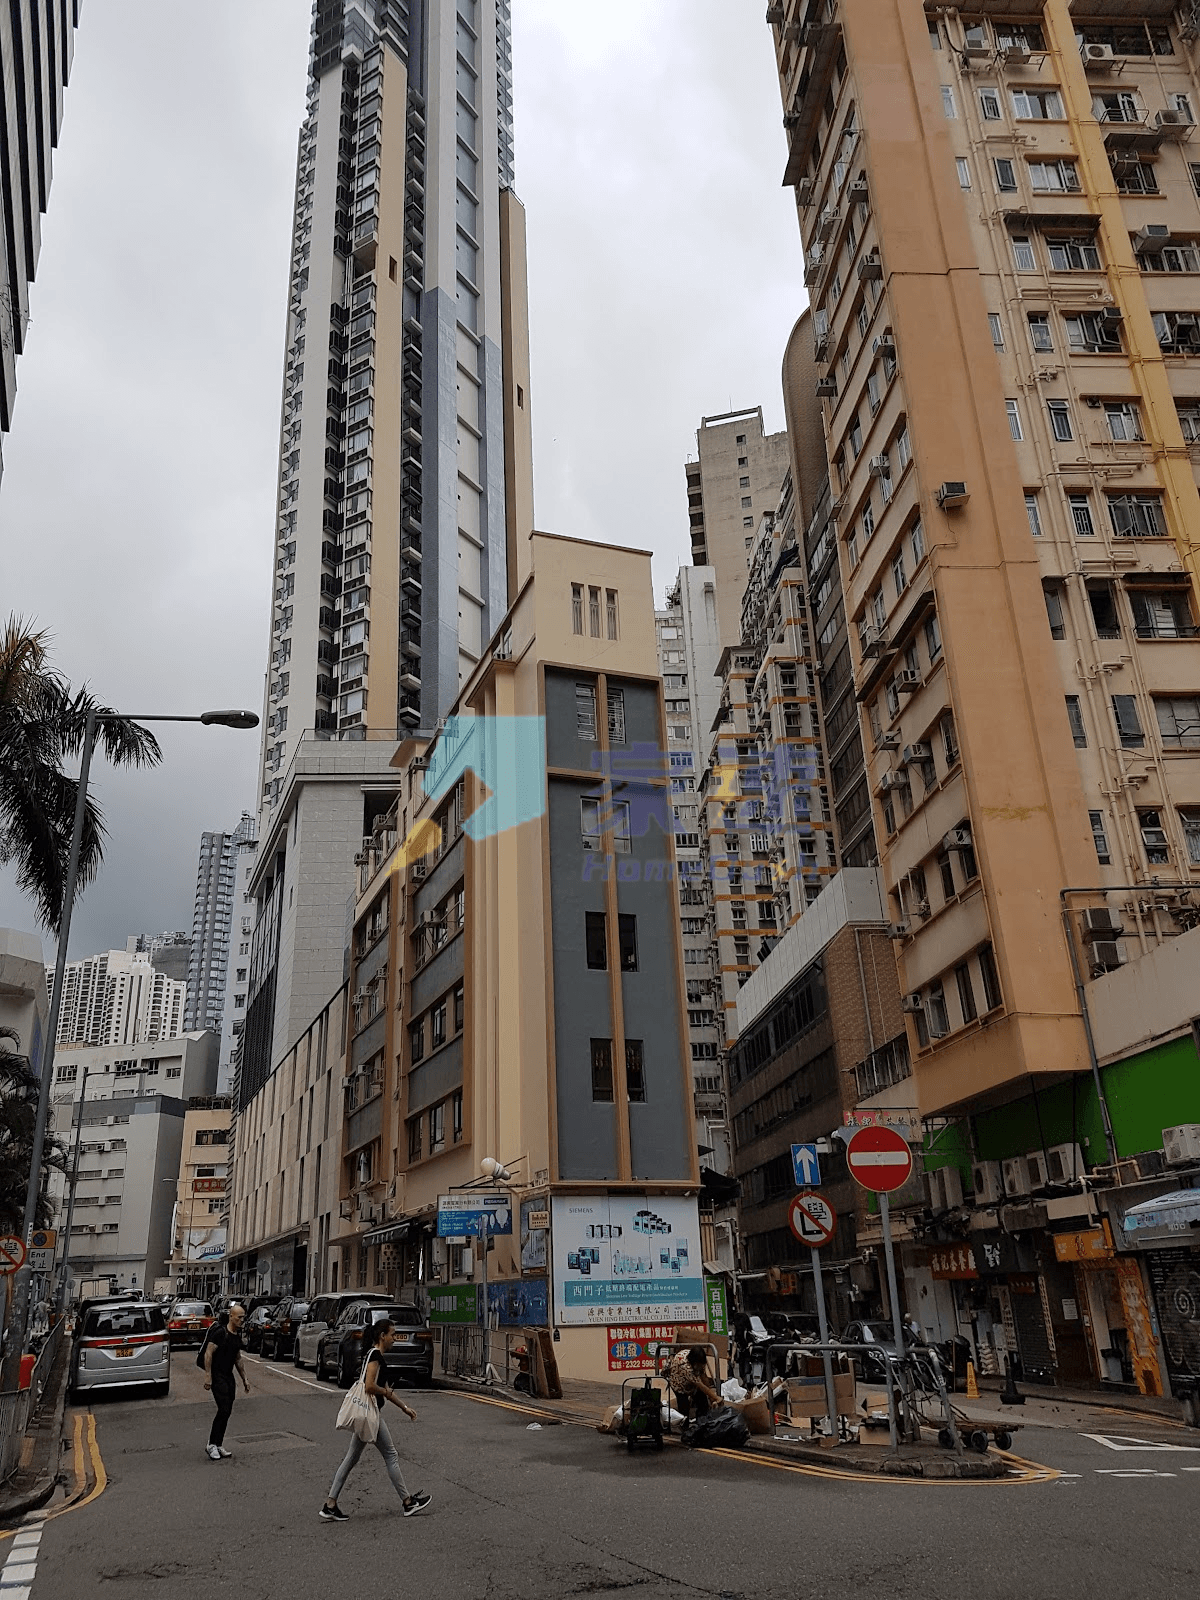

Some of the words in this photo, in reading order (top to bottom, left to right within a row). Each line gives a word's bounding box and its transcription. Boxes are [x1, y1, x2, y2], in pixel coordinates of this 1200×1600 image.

[709, 1287, 724, 1333] 百福車
[616, 1342, 637, 1358] 批發
